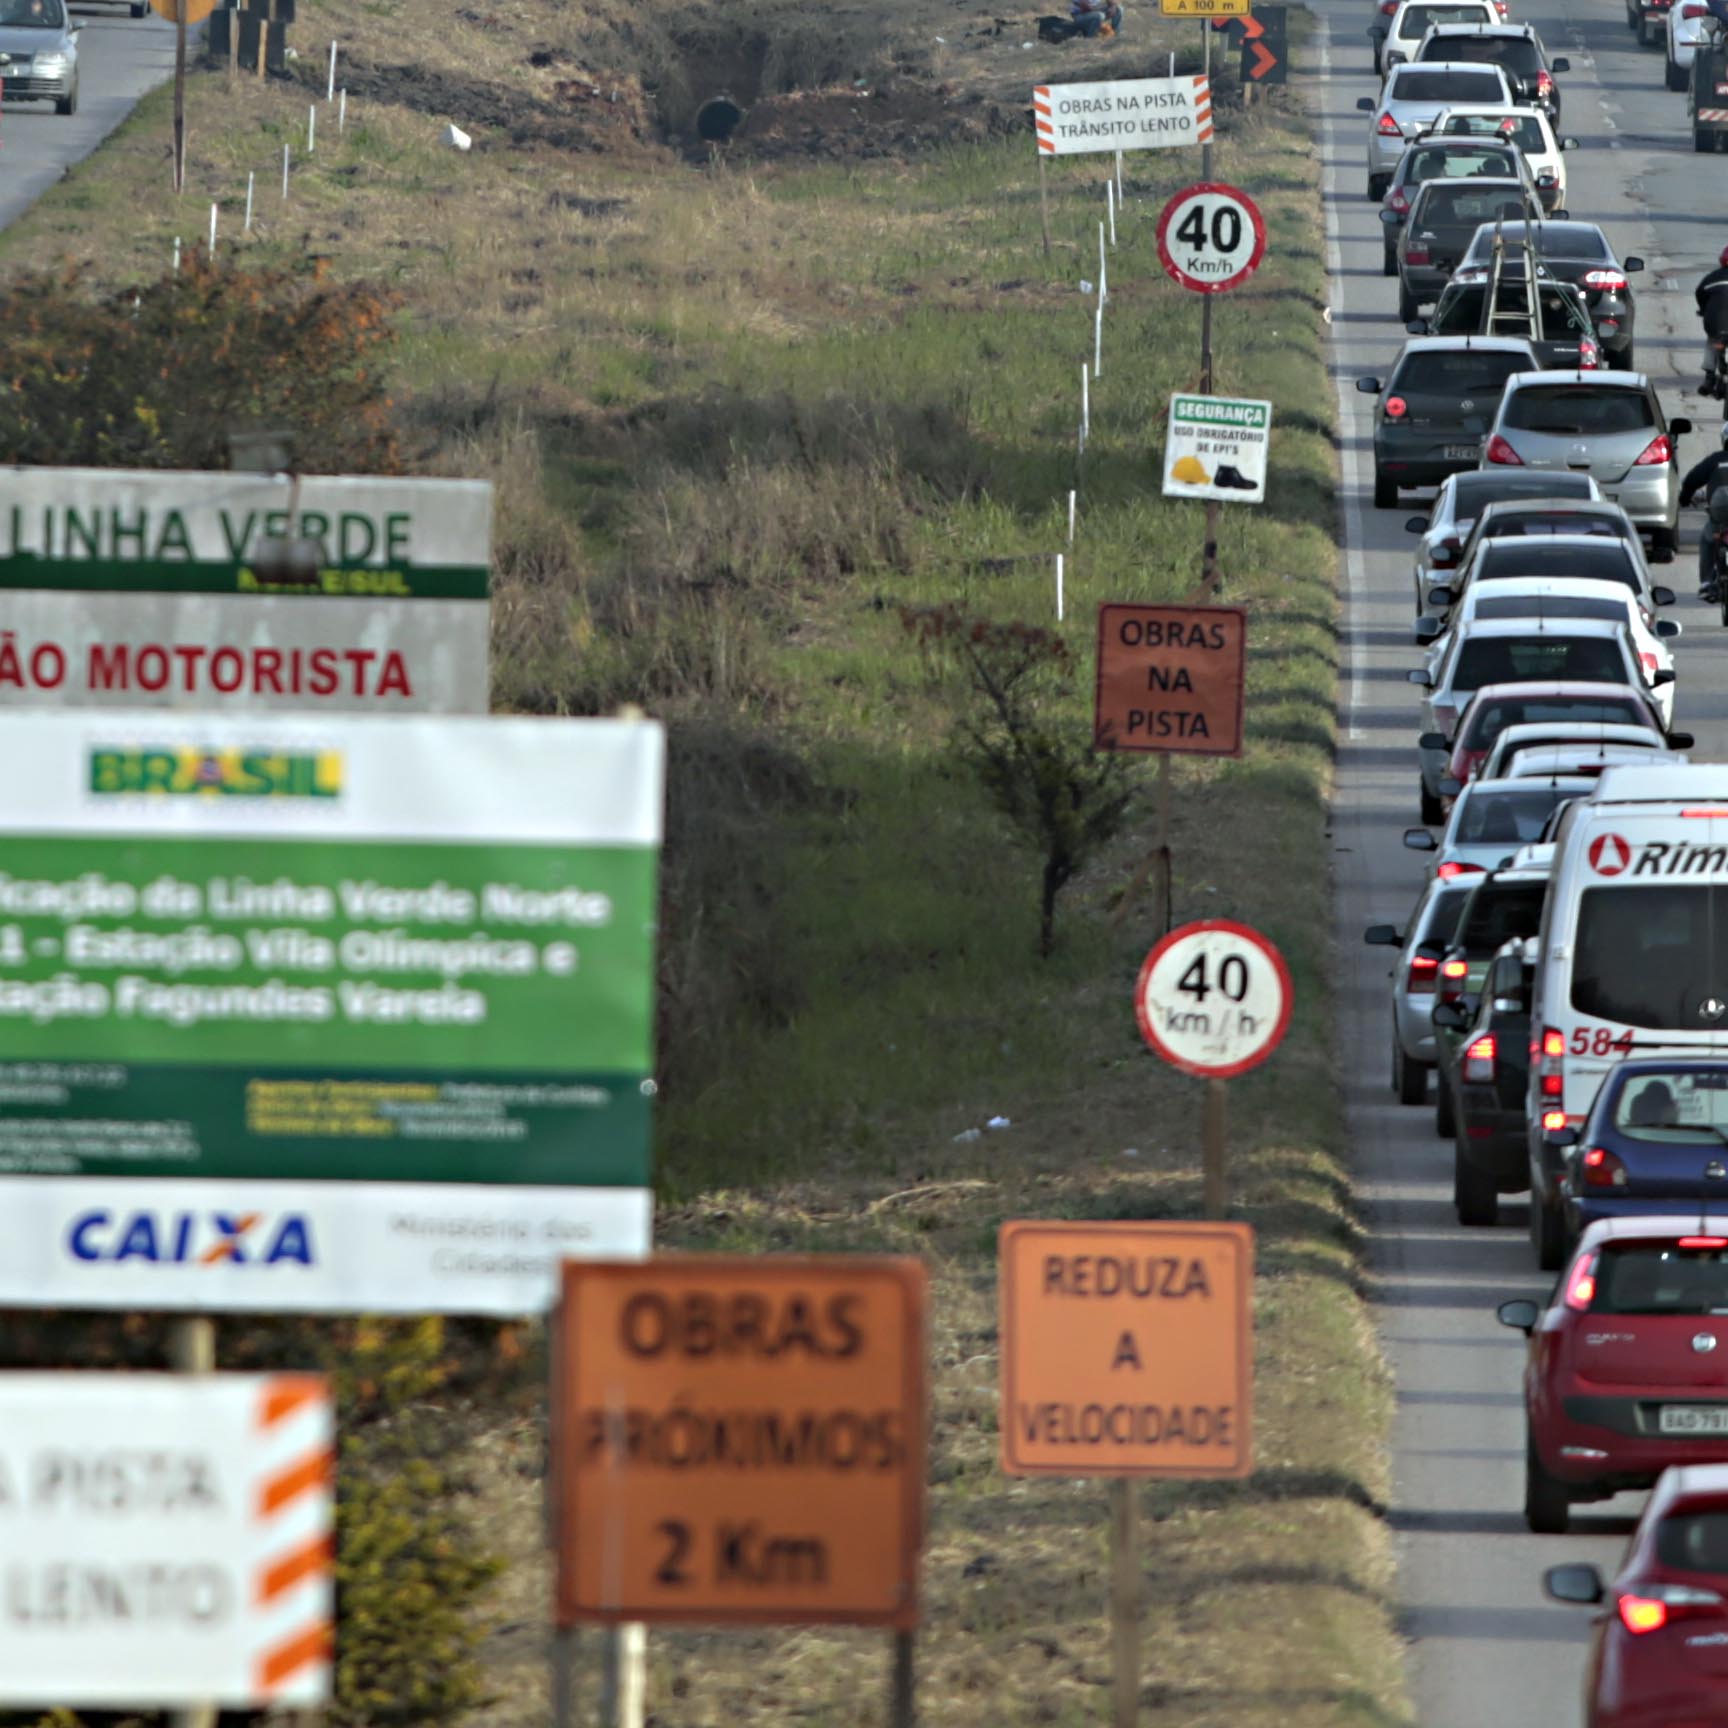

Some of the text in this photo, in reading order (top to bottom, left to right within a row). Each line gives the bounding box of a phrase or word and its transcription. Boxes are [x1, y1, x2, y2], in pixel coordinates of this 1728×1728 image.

[1178, 0, 1234, 10] A 100 m
[1059, 92, 1186, 115] OBRAS NA PISTA
[1059, 116, 1191, 138] TRÂNSITO LENTO
[1176, 205, 1242, 253] 40
[1187, 258, 1233, 273] Km/h
[1174, 426, 1264, 443] USO OBRIGATÓRIO
[1176, 401, 1264, 425] SEGURANÇA
[1196, 441, 1210, 453] DE
[10, 505, 411, 567] LINHA VERDE
[1120, 619, 1225, 650] OBRAS
[87, 644, 415, 698] MOTORISTA
[1148, 666, 1193, 693] NA
[1127, 709, 1210, 739] PISTA
[89, 746, 342, 798] BRASIL
[210, 876, 330, 921] Linha
[341, 880, 472, 927] Verde
[482, 882, 611, 927] Norte
[67, 927, 237, 976] Estação
[247, 928, 331, 972] Vila
[341, 929, 534, 980] Olímpica
[544, 940, 576, 978] e
[116, 975, 334, 1029] Fagundes
[341, 977, 486, 1026] Varela
[1177, 953, 1249, 1005] 40
[1570, 1027, 1635, 1057] 584
[63, 1208, 318, 1268] CAIXA
[1043, 1254, 1211, 1300] REDUZA
[621, 1291, 864, 1360] OBRAS
[1113, 1330, 1141, 1372] A
[584, 1389, 903, 1471] PRÓXIMOS
[1019, 1404, 1235, 1448] VELOCIDADE
[29, 1450, 220, 1512] PISTA
[653, 1520, 828, 1587] 2 Km
[8, 1562, 234, 1625] LENTO
